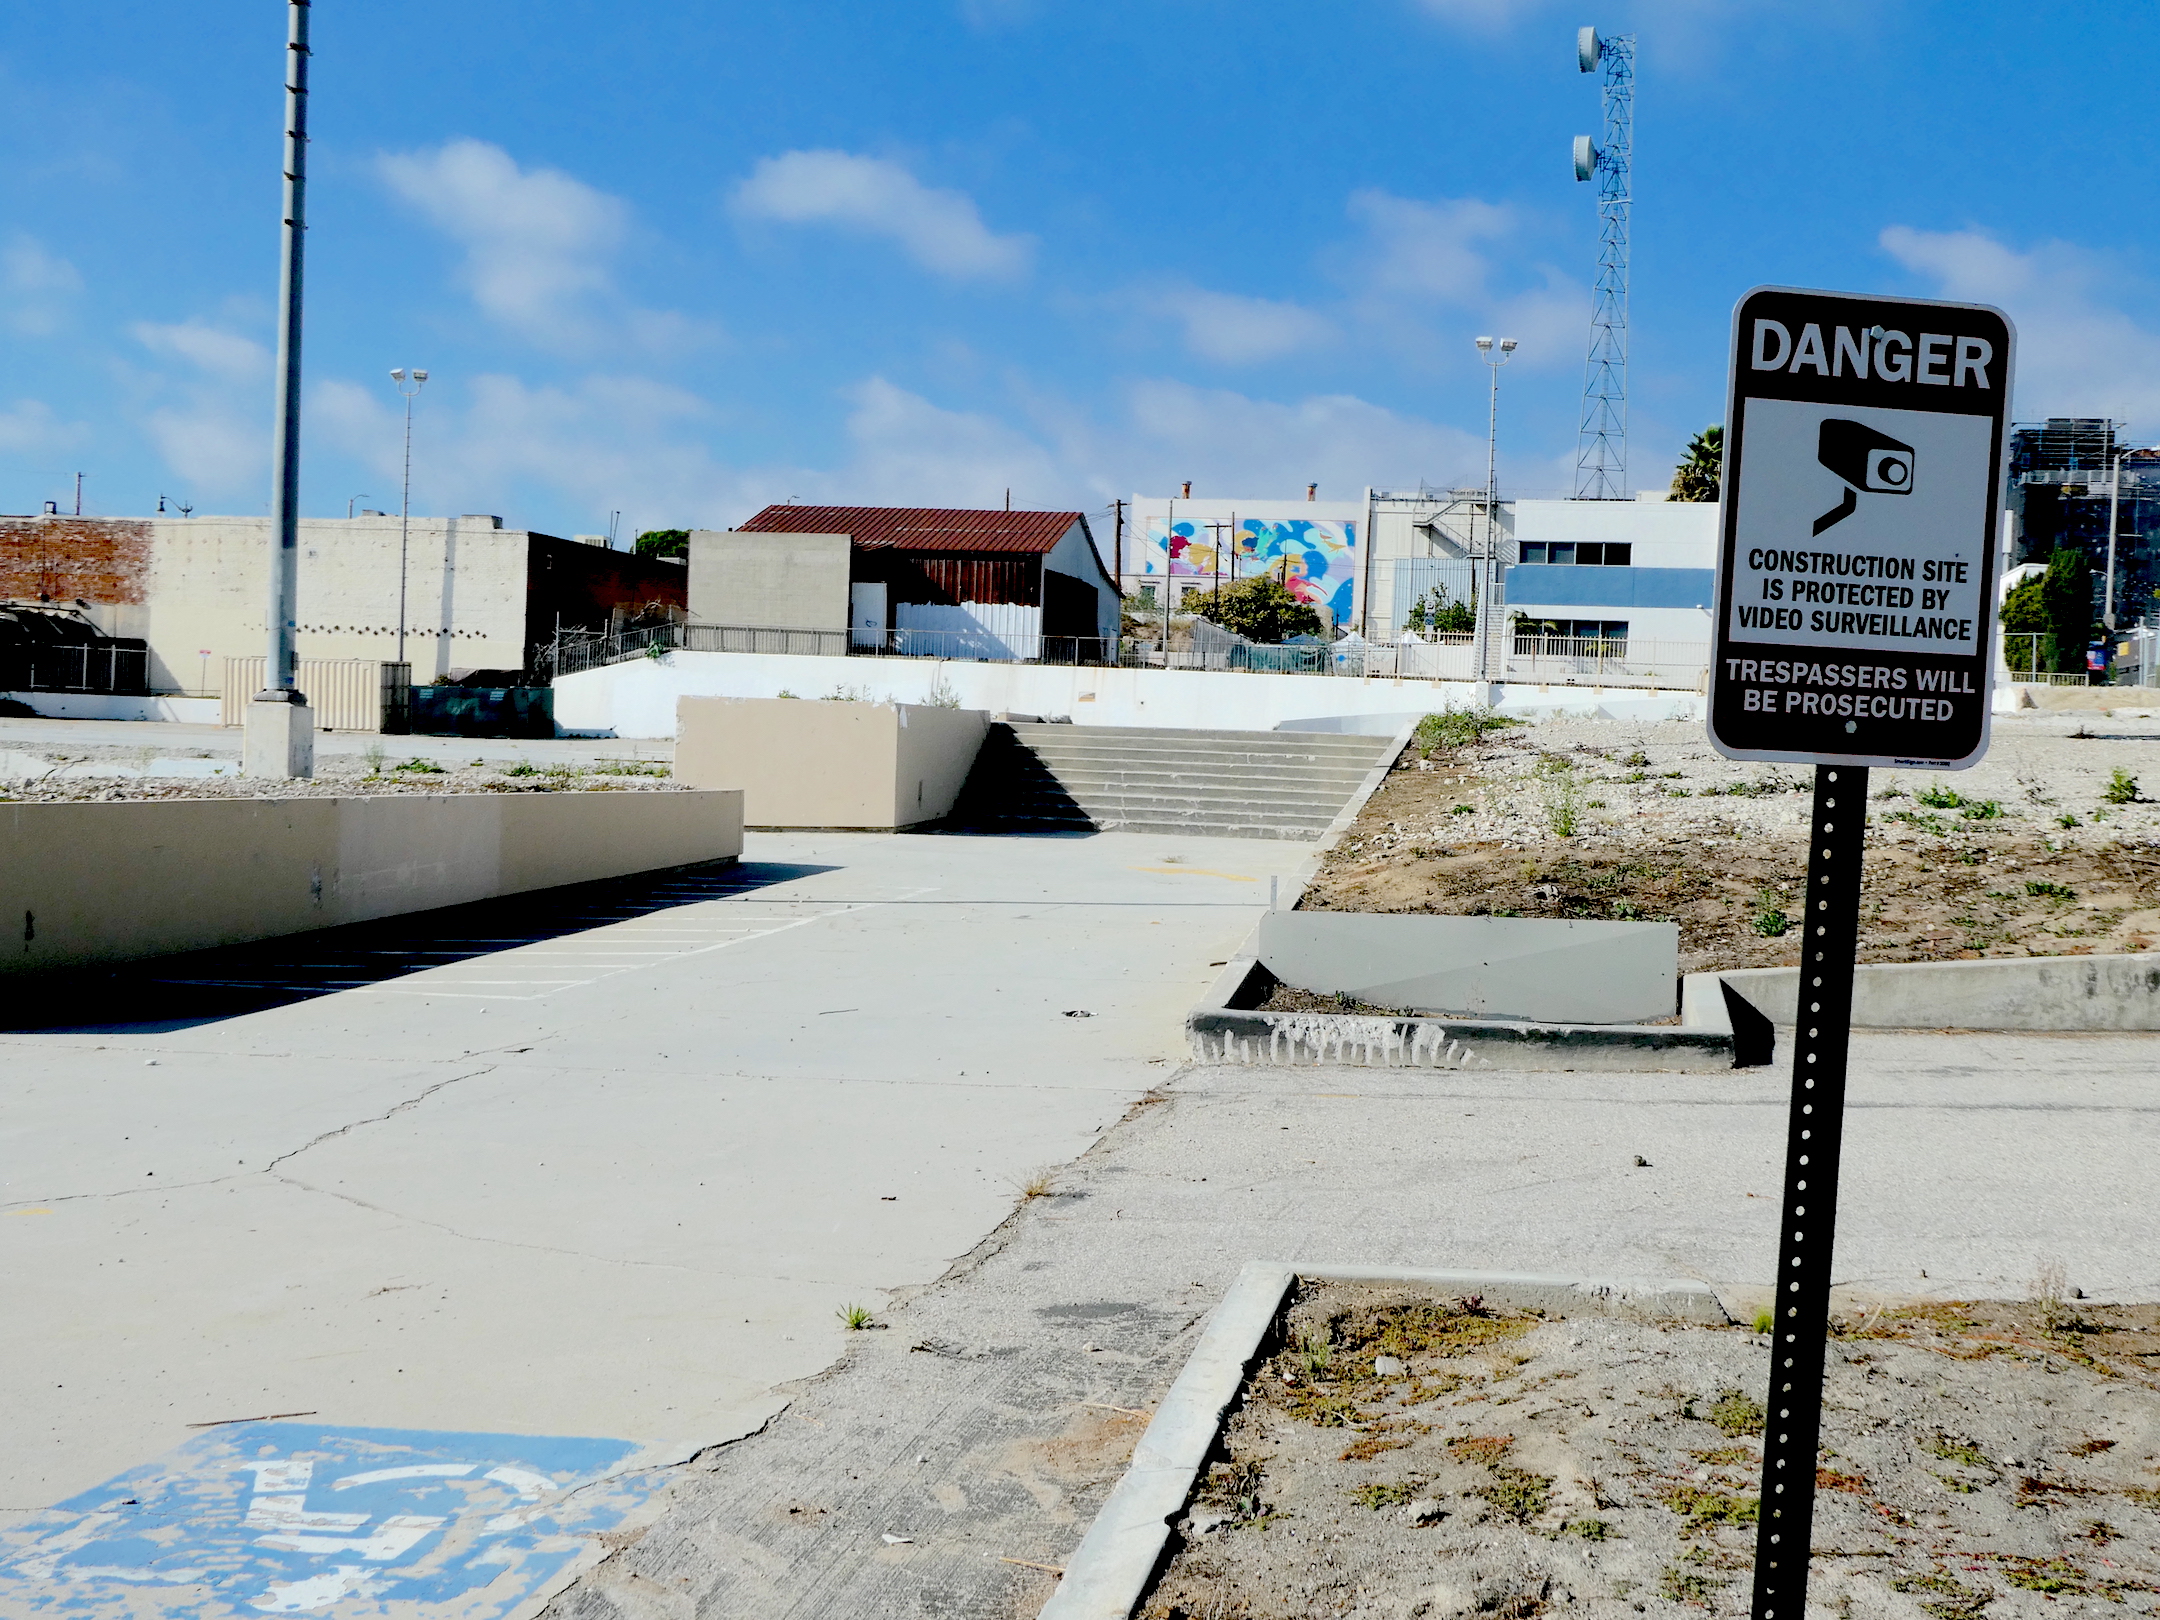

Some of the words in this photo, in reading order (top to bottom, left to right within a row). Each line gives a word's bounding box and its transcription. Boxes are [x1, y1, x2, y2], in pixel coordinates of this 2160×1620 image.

[1751, 318, 1993, 389] DANGER
[1749, 548, 1915, 580] CONSTRUCTION
[1922, 560, 1969, 584] SITE
[1762, 578, 1784, 601] IS
[1791, 580, 1914, 609] PROTECTED
[1922, 588, 1950, 611] BY
[1738, 605, 1803, 631] VIDEO
[1810, 610, 1972, 641] SURVEILLANCE
[1726, 658, 1908, 690] TRESPASSERS
[1915, 669, 1976, 694] WILL
[1743, 689, 1779, 713] BE
[1785, 691, 1954, 722] PROSECUTED
